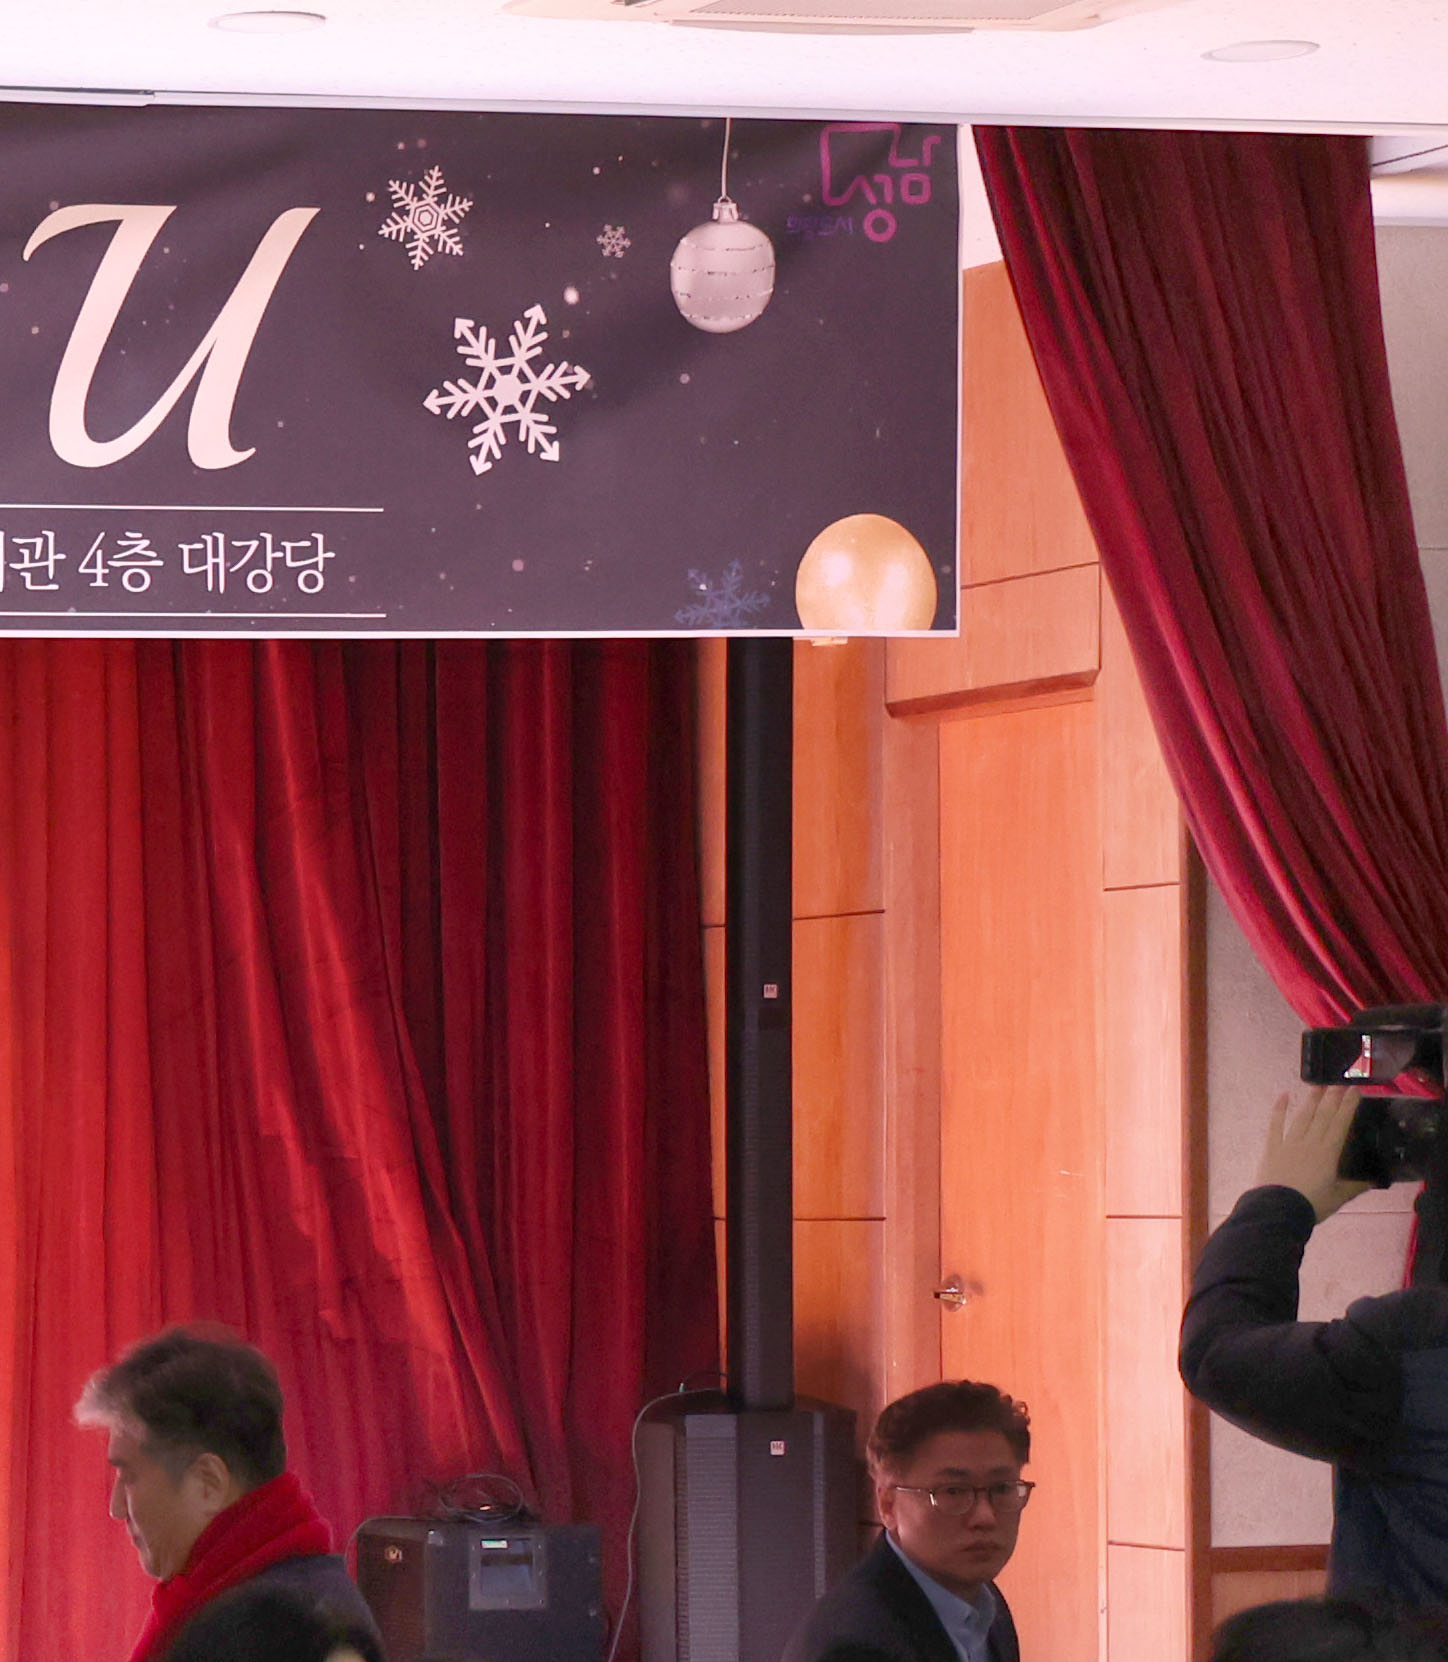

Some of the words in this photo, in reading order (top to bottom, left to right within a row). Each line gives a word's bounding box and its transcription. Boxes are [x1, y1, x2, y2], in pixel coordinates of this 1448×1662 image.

[23, 204, 320, 469] U
[79, 532, 163, 592] 4층
[178, 532, 335, 593] 대강당
